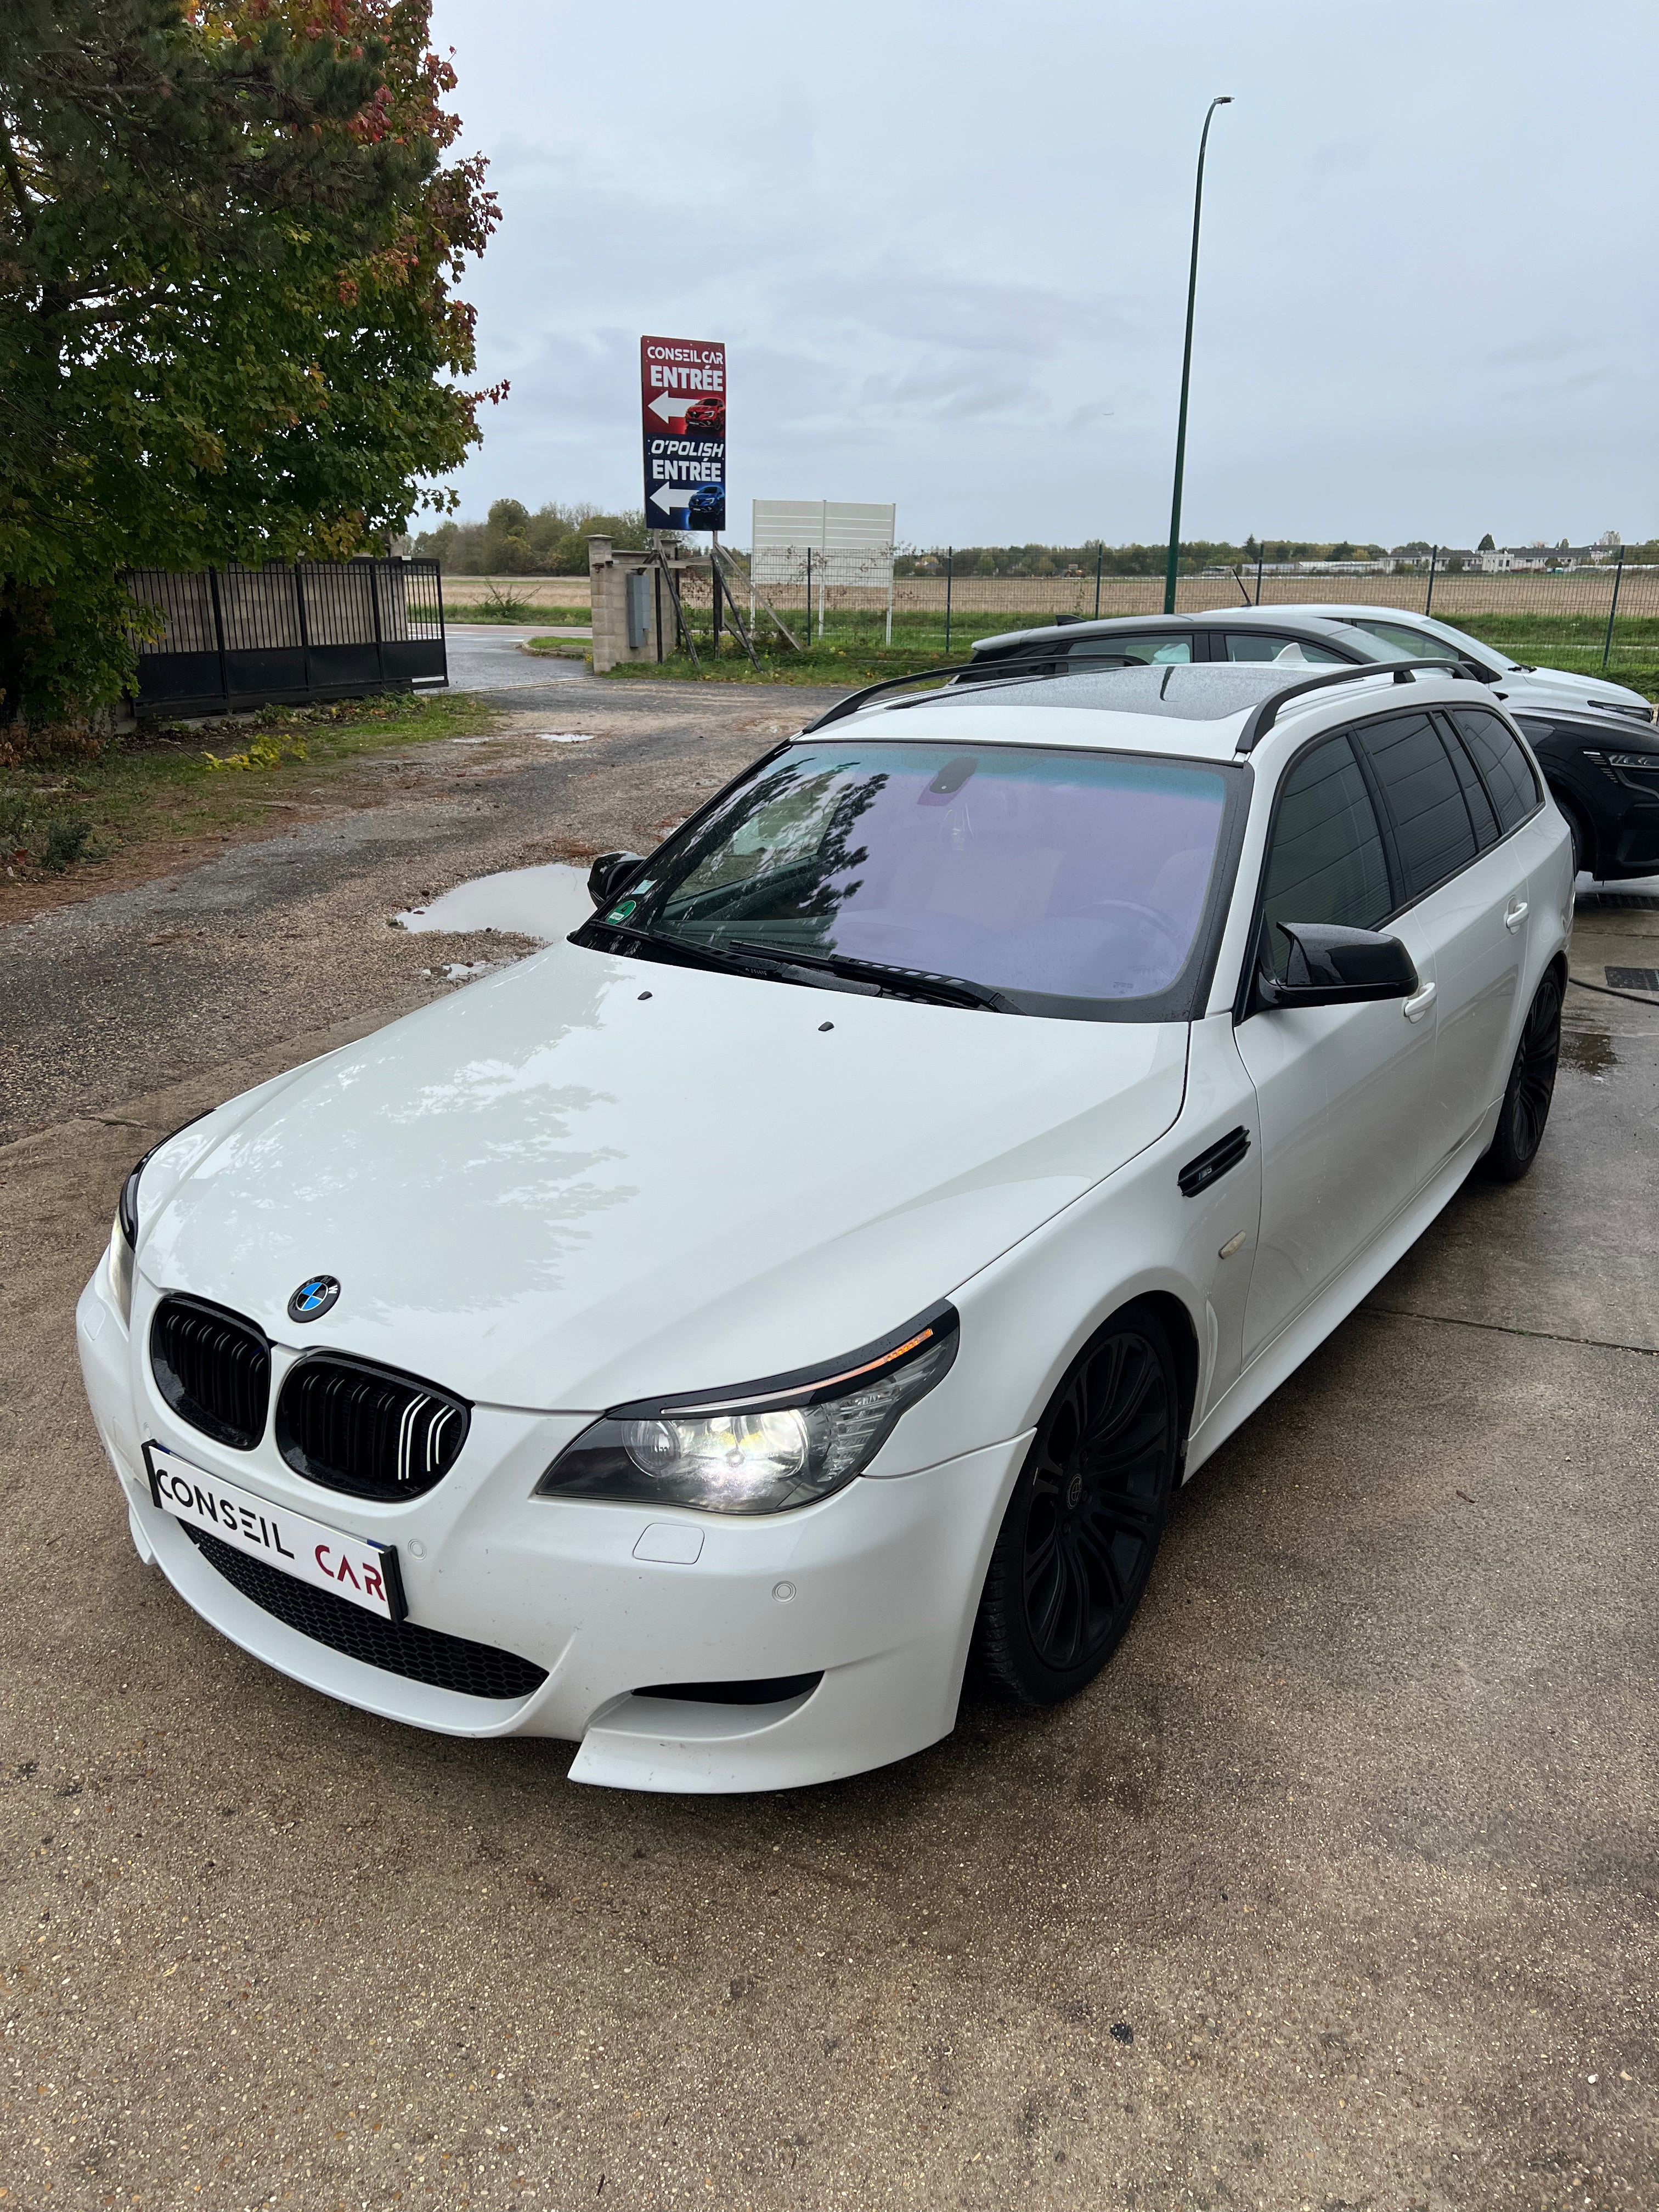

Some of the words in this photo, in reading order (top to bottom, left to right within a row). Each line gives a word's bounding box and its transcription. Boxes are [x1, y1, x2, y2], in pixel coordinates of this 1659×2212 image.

[647, 346, 701, 363] CONSEIL
[702, 351, 724, 365] CAR
[650, 365, 724, 392] ENTRÉE
[651, 439, 725, 458] O'POLISH
[652, 458, 721, 482] ENTRÉE
[155, 1469, 295, 1560] CONSEIL
[314, 1544, 386, 1601] CAR
